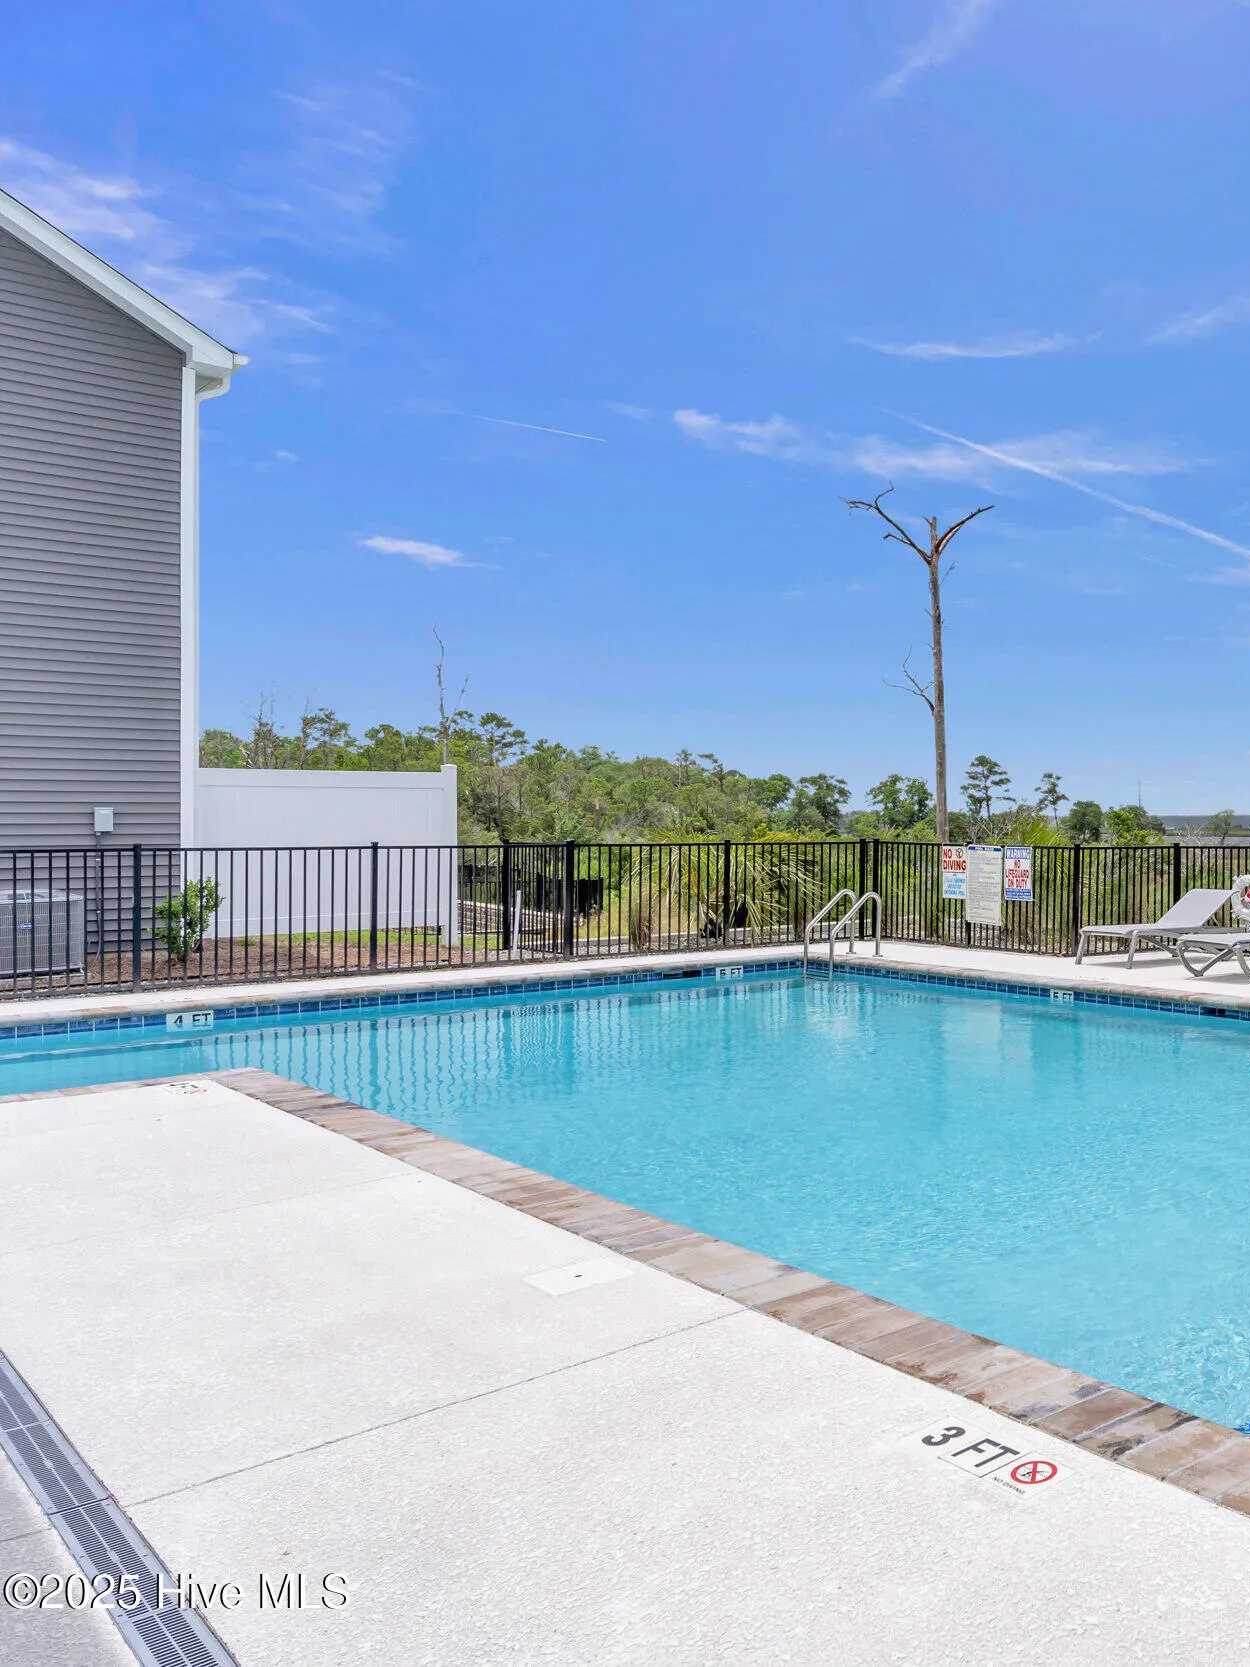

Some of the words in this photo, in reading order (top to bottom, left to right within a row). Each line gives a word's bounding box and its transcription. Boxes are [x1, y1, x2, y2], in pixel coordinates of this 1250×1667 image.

[943, 849, 952, 859] NO
[1006, 848, 1030, 859] WARNING
[943, 860, 967, 870] DIVING
[1014, 860, 1020, 868] NO
[1005, 869, 1030, 878] LIFEGUARD
[1008, 879, 1014, 887] ON
[1016, 879, 1027, 888] DUTY
[731, 968, 742, 978] FT
[1063, 993, 1072, 1001] FT
[192, 1013, 211, 1023] FT
[921, 1426, 966, 1446] 3
[951, 1438, 1020, 1468] FT
